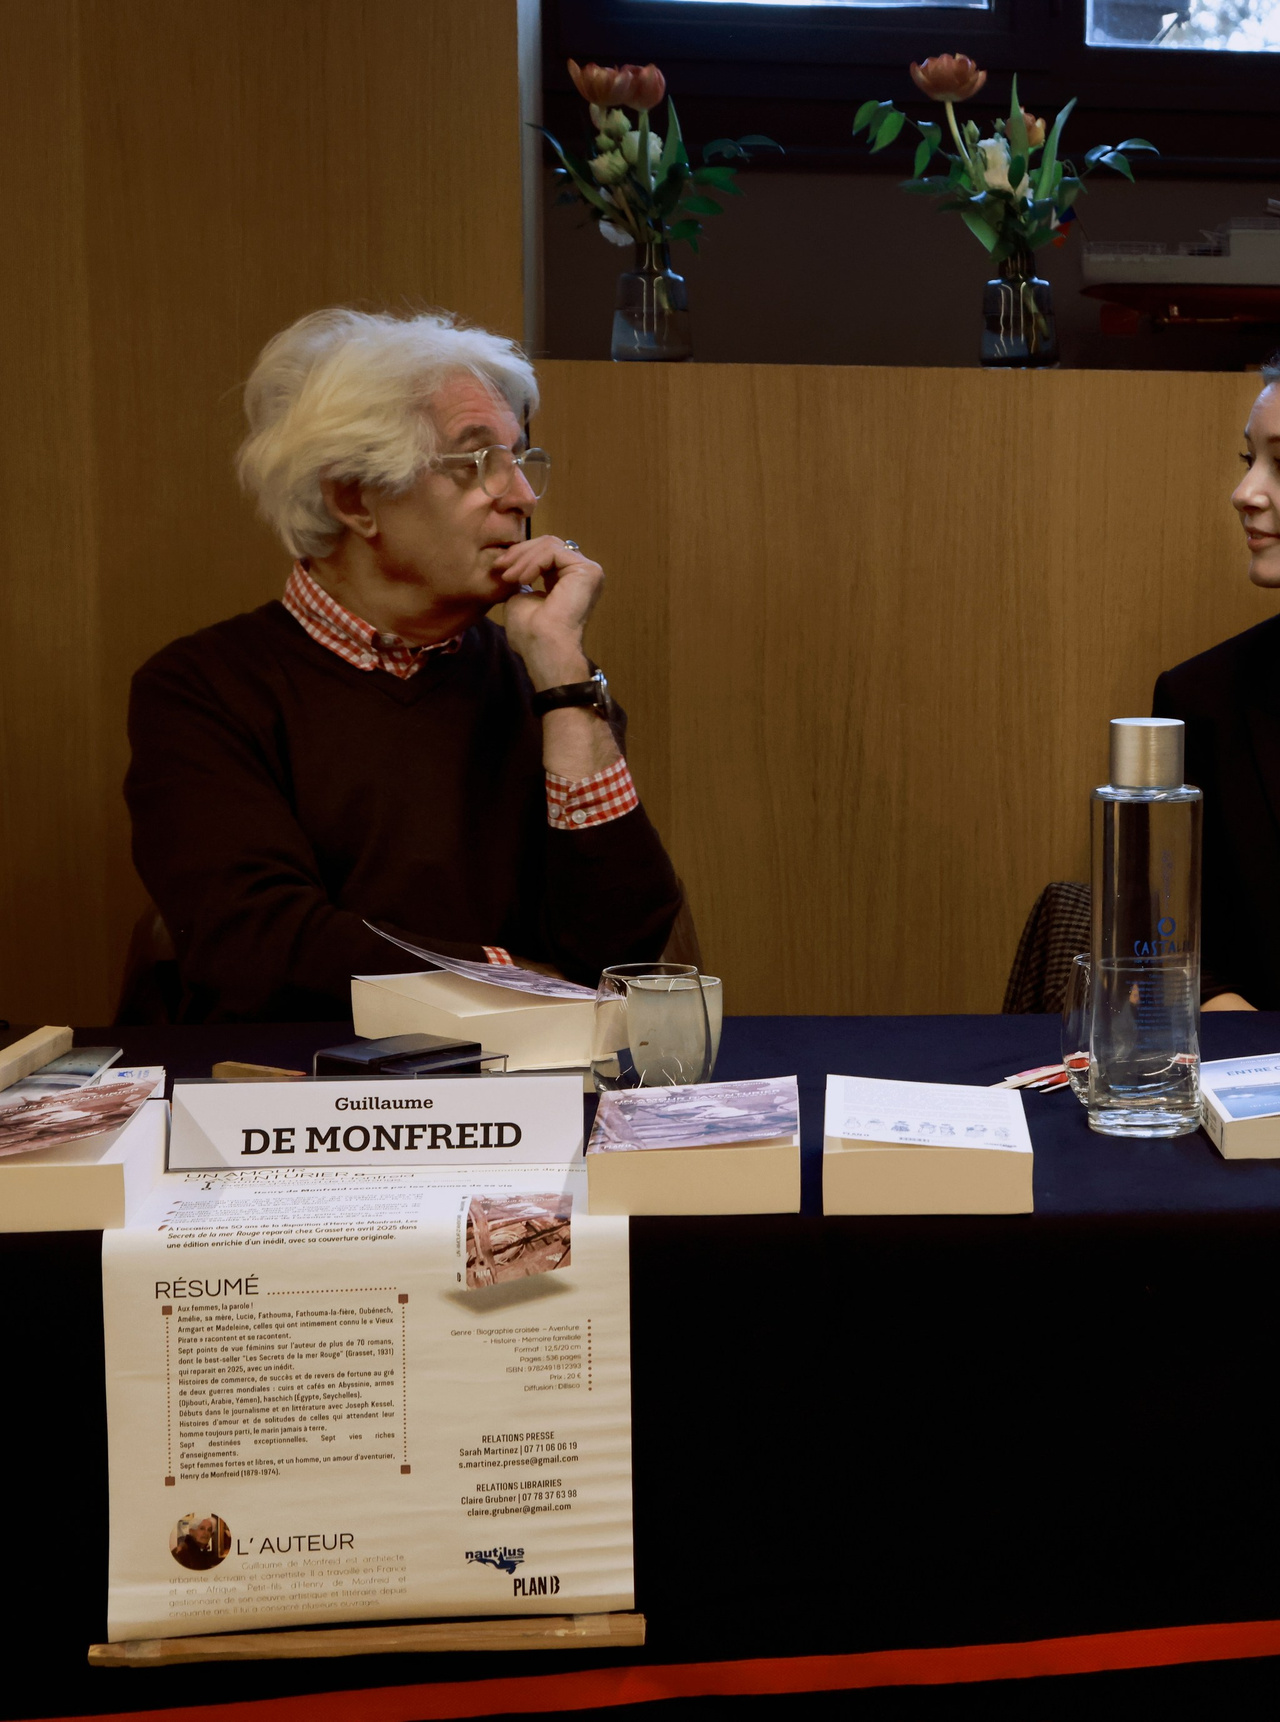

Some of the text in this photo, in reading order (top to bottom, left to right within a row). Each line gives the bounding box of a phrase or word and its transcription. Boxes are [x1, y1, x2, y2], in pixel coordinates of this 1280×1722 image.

[1226, 1066, 1272, 1076] ENTRE
[335, 1096, 433, 1110] Guillaume
[241, 1122, 521, 1154] DE MONFREID
[360, 1233, 395, 1241] originale.
[155, 1275, 258, 1299] RÉSUMÉ
[228, 1302, 249, 1311] parole
[258, 1311, 293, 1319] Fathouma,
[177, 1326, 204, 1334] Armgart
[274, 1322, 285, 1330] qui
[177, 1347, 193, 1355] Sept
[196, 1347, 217, 1355] points
[329, 1340, 343, 1348] plus
[204, 1355, 240, 1363] best-seller
[259, 1353, 284, 1361] Secrets
[377, 1347, 394, 1355] 1931)
[178, 1368, 189, 1377] qui
[227, 1365, 245, 1373] 2025,
[205, 1430, 233, 1438] toujours
[234, 1428, 252, 1436] parti,
[280, 1426, 302, 1435] jamais
[481, 1431, 554, 1443] RELATIONS PRESSE
[179, 1441, 194, 1449] Sept
[320, 1434, 335, 1442] Sept
[459, 1447, 482, 1456] Sarah
[483, 1447, 518, 1455] Martinez
[523, 1444, 533, 1453] 07
[535, 1444, 543, 1452] 71
[545, 1443, 555, 1451] 06
[557, 1442, 567, 1450] 06
[568, 1441, 577, 1449] 19
[180, 1450, 238, 1459] d'enseignements.
[458, 1454, 578, 1468] s.martinez.presse@gmail.com
[210, 1469, 239, 1478] Monfreid
[476, 1478, 561, 1491] RELATIONS LIBRAIRIES
[460, 1496, 483, 1505] Claire
[484, 1494, 516, 1503] Grubner
[521, 1492, 531, 1501] 07
[533, 1491, 543, 1500] 78
[544, 1490, 554, 1499] 37
[555, 1490, 565, 1498] 63
[567, 1489, 577, 1497] 98
[467, 1503, 571, 1517] claire.grubner@gmail.com
[236, 1533, 354, 1556] L' AUTEUR
[465, 1546, 525, 1560] nautilus
[513, 1576, 547, 1596] PLAN
